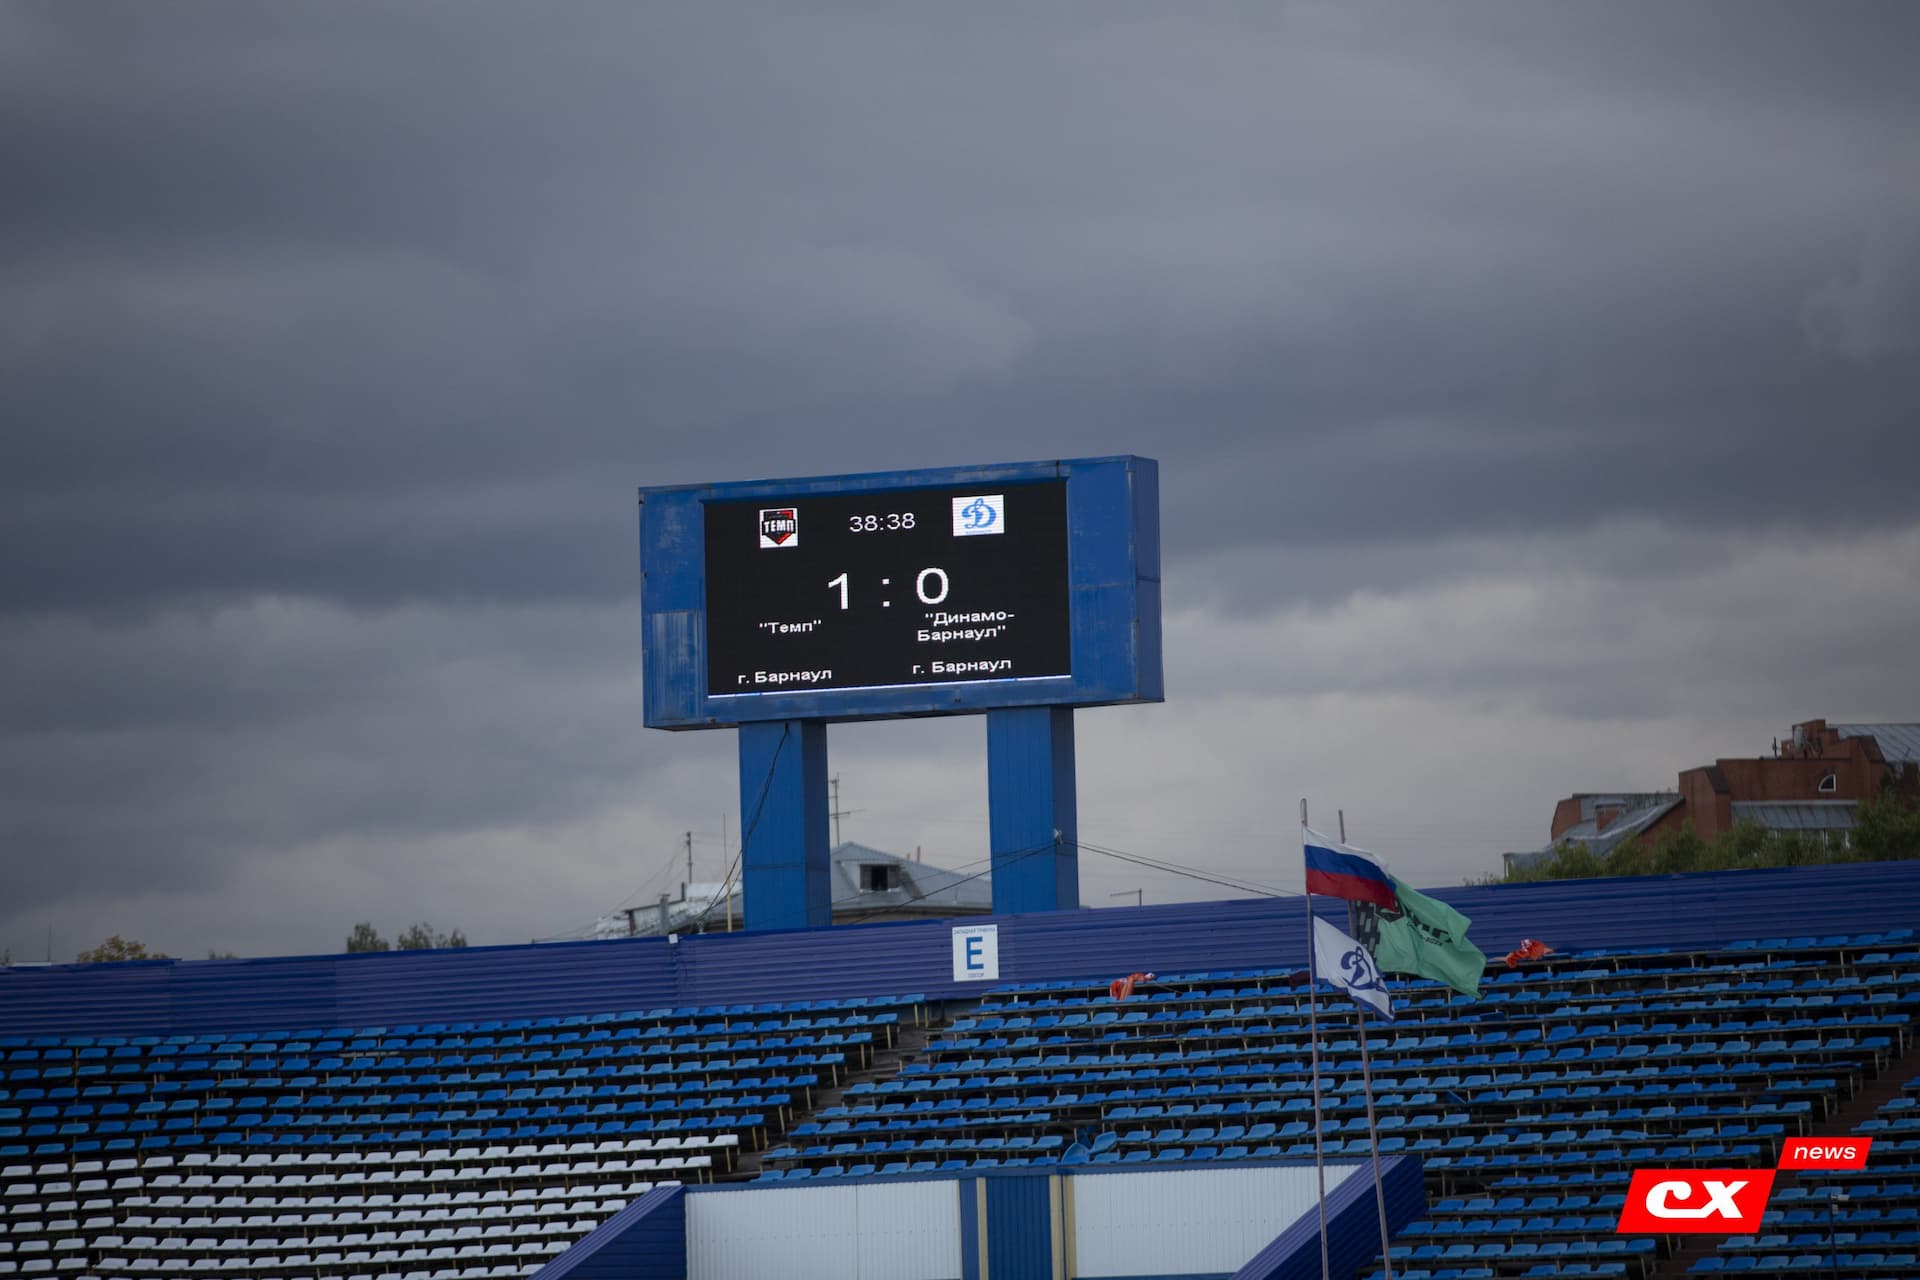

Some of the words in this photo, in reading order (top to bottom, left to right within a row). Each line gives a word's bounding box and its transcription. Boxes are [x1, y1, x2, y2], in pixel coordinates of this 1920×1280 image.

[763, 519, 795, 534] ТЕМП
[849, 512, 916, 533] 38:38
[828, 572, 850, 610] 1
[916, 567, 949, 605] 0
[759, 619, 822, 634] "Темп"
[924, 610, 1016, 626] "Динамо-
[917, 625, 1006, 643] Барнаул"
[912, 664, 925, 675] г.
[931, 658, 1012, 676] Барнаул
[738, 674, 750, 685] г.
[754, 668, 833, 685] Барнаул
